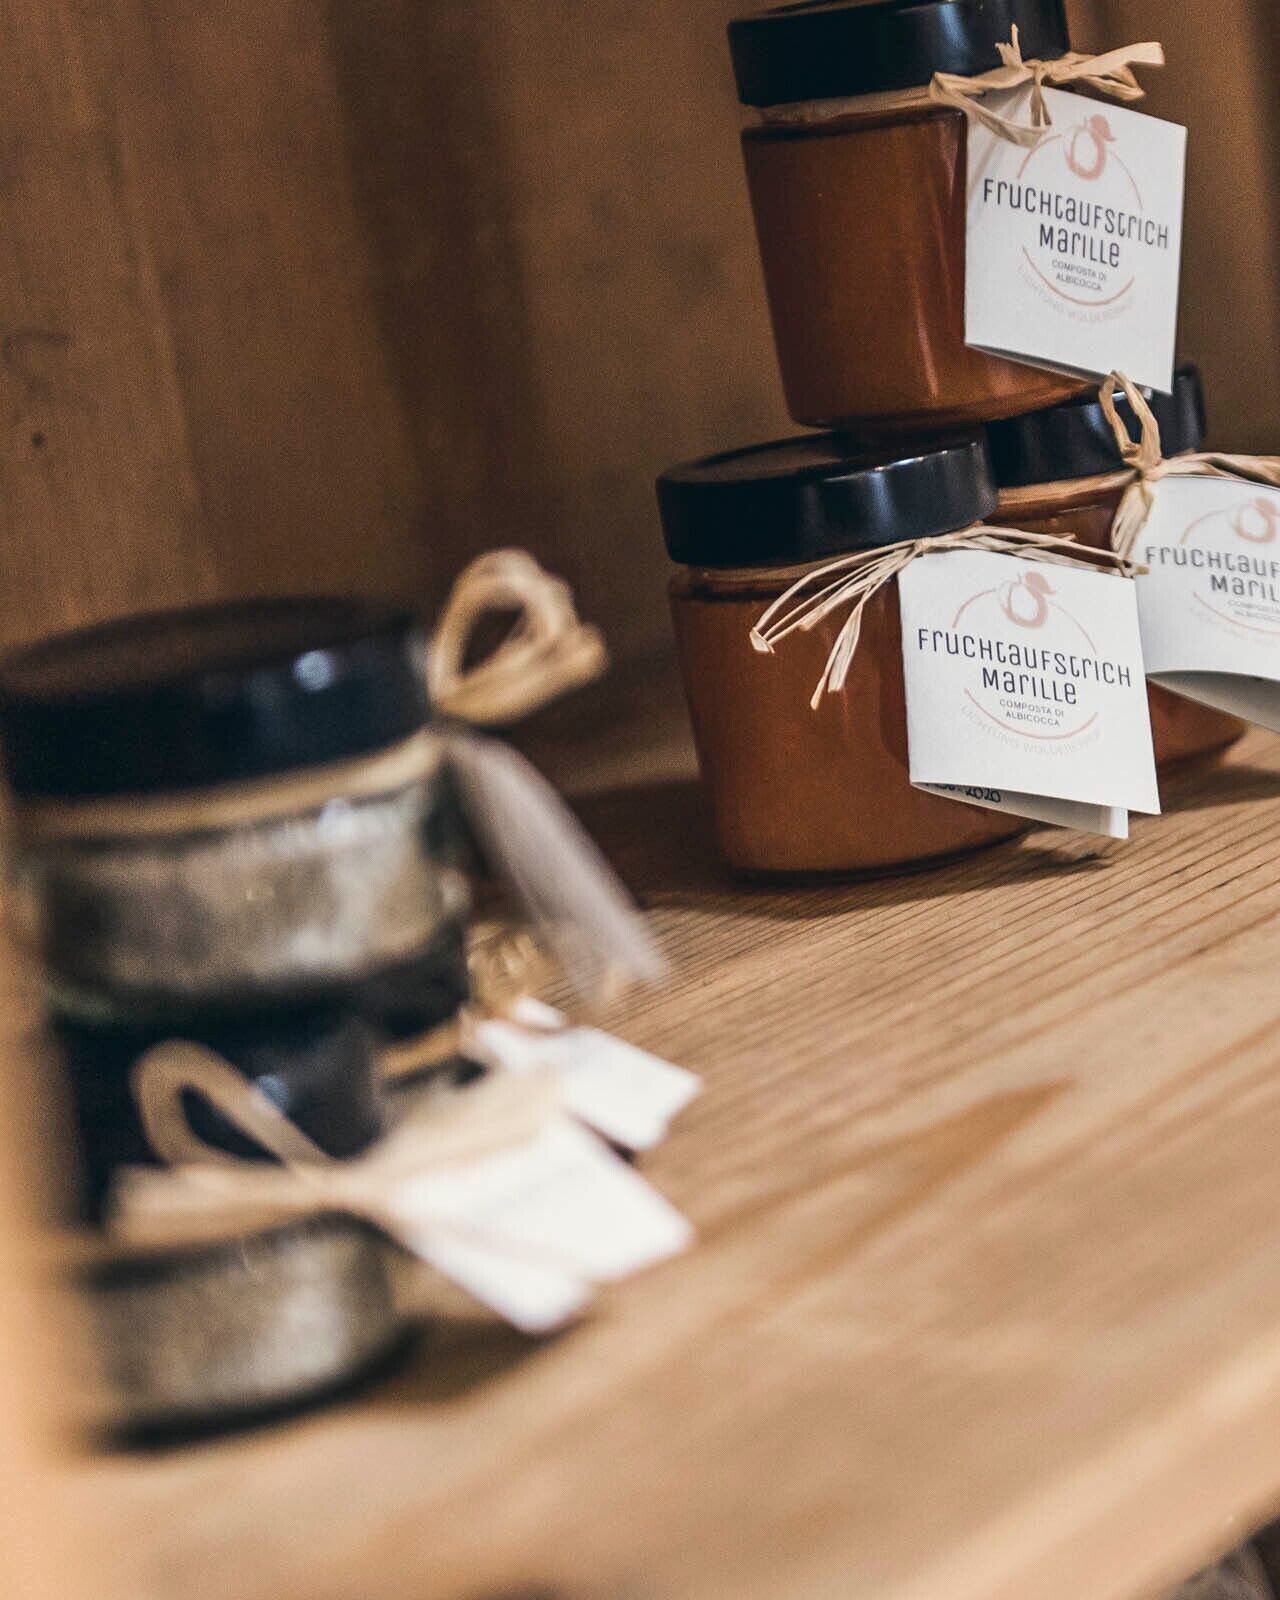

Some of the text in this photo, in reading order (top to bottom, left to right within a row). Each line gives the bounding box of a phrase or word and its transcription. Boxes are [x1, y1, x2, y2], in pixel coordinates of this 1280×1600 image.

[1051, 260, 1096, 280] COMPOSTA
[999, 698, 1065, 717] COMPOSTA DI
[1005, 710, 1060, 727] ALBICOCCA
